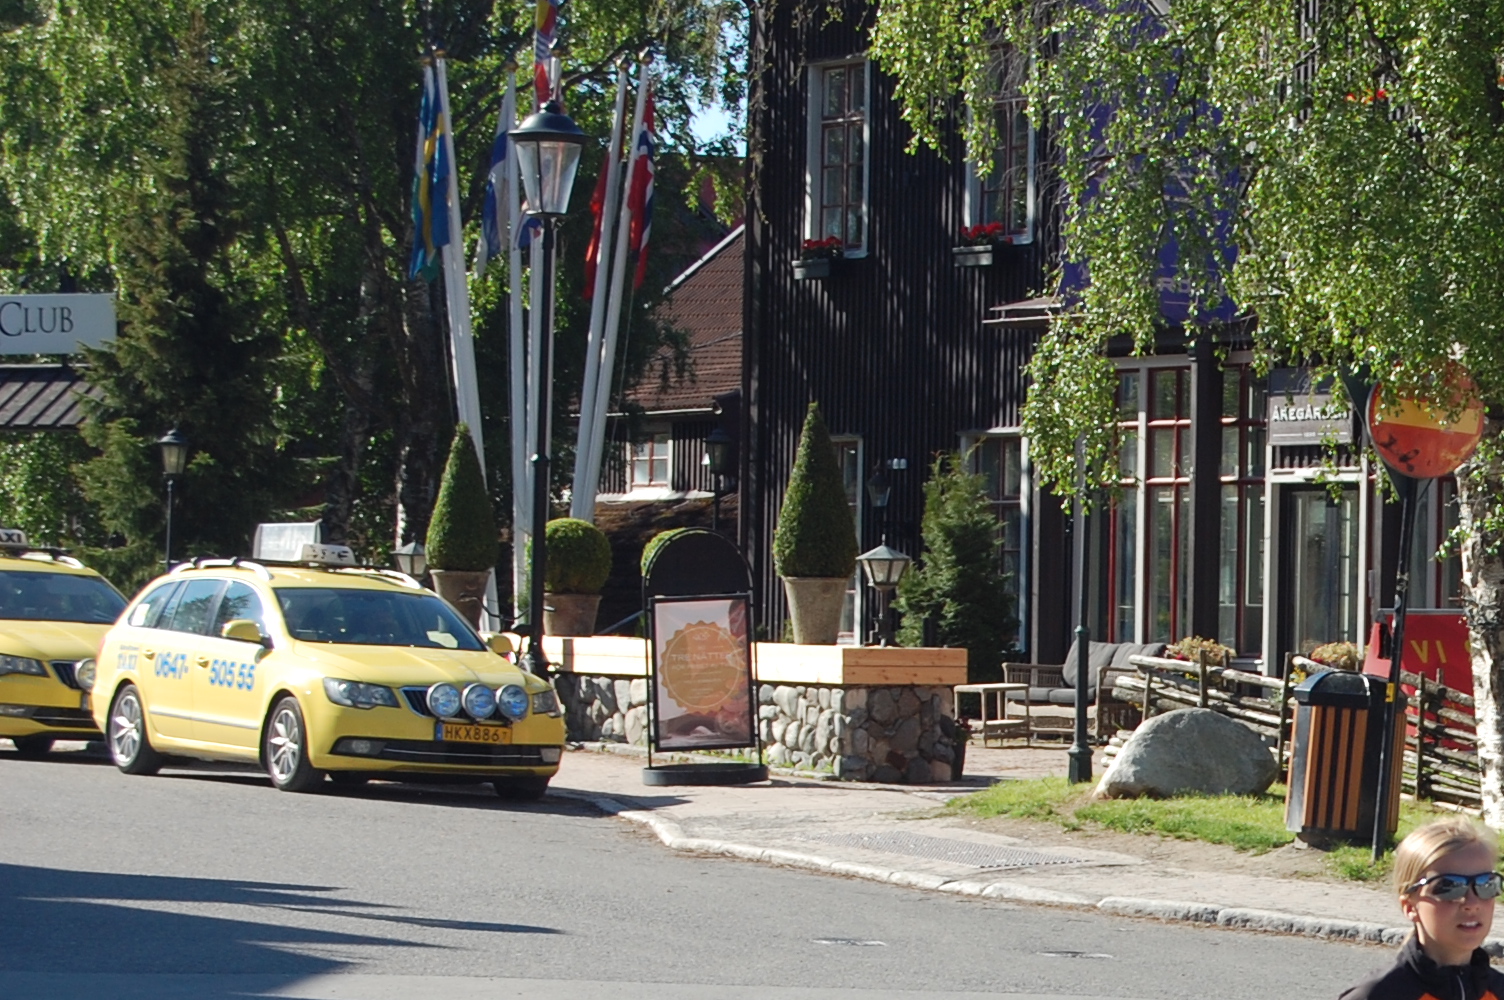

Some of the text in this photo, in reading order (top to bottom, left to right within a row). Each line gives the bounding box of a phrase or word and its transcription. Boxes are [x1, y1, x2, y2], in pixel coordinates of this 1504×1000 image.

[0, 301, 74, 337] CLUB
[1410, 640, 1447, 664] VI
[444, 725, 500, 742] HKX886
